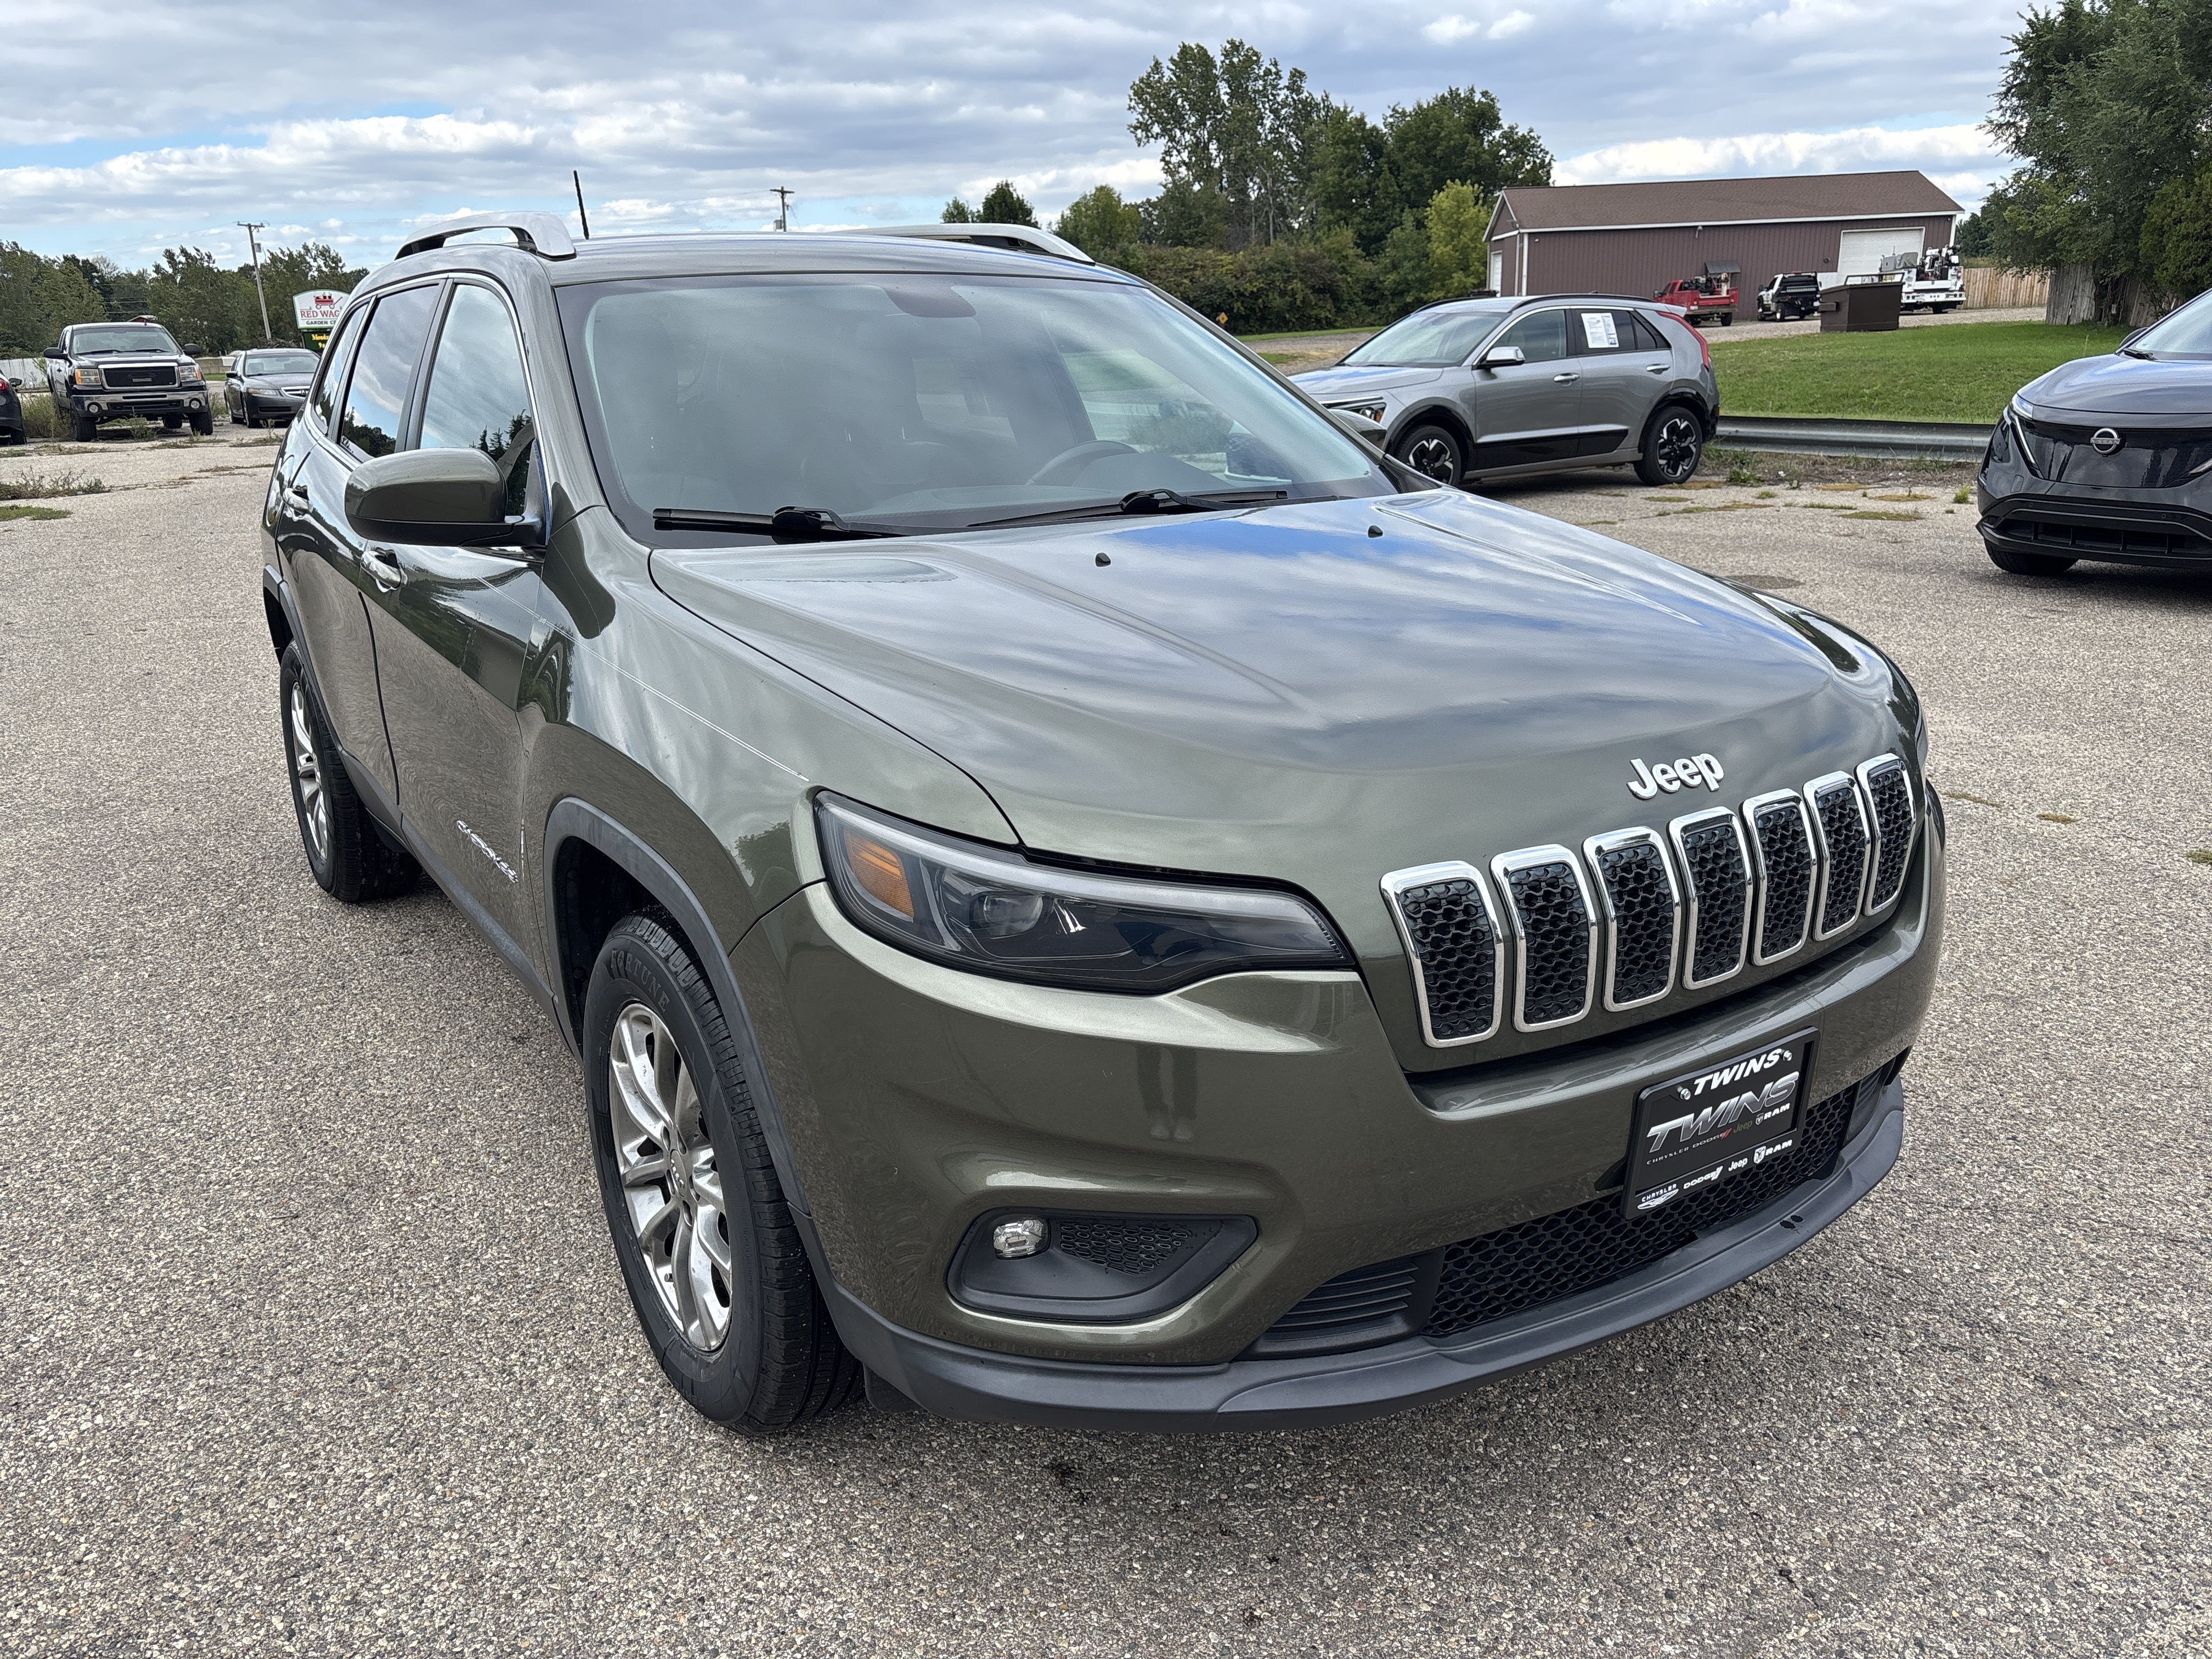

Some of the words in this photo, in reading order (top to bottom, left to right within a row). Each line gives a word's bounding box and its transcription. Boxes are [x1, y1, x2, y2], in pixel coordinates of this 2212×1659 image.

[1627, 753, 1724, 799] Jeep
[611, 950, 670, 1013] FORTUNE
[1694, 1048, 1781, 1096] TWINS
[1647, 1071, 1799, 1153] TWINS
[1647, 1147, 1689, 1165] CHRYSLER
[1692, 1132, 1726, 1148] DODGE
[1734, 1120, 1753, 1133] Jeep
[1764, 1103, 1790, 1120] RAM
[1641, 1183, 1677, 1202] CHRYSLER
[1684, 1171, 1718, 1189] DODGE
[1729, 1158, 1748, 1171] Jeep
[1765, 1139, 1792, 1155] RAM
